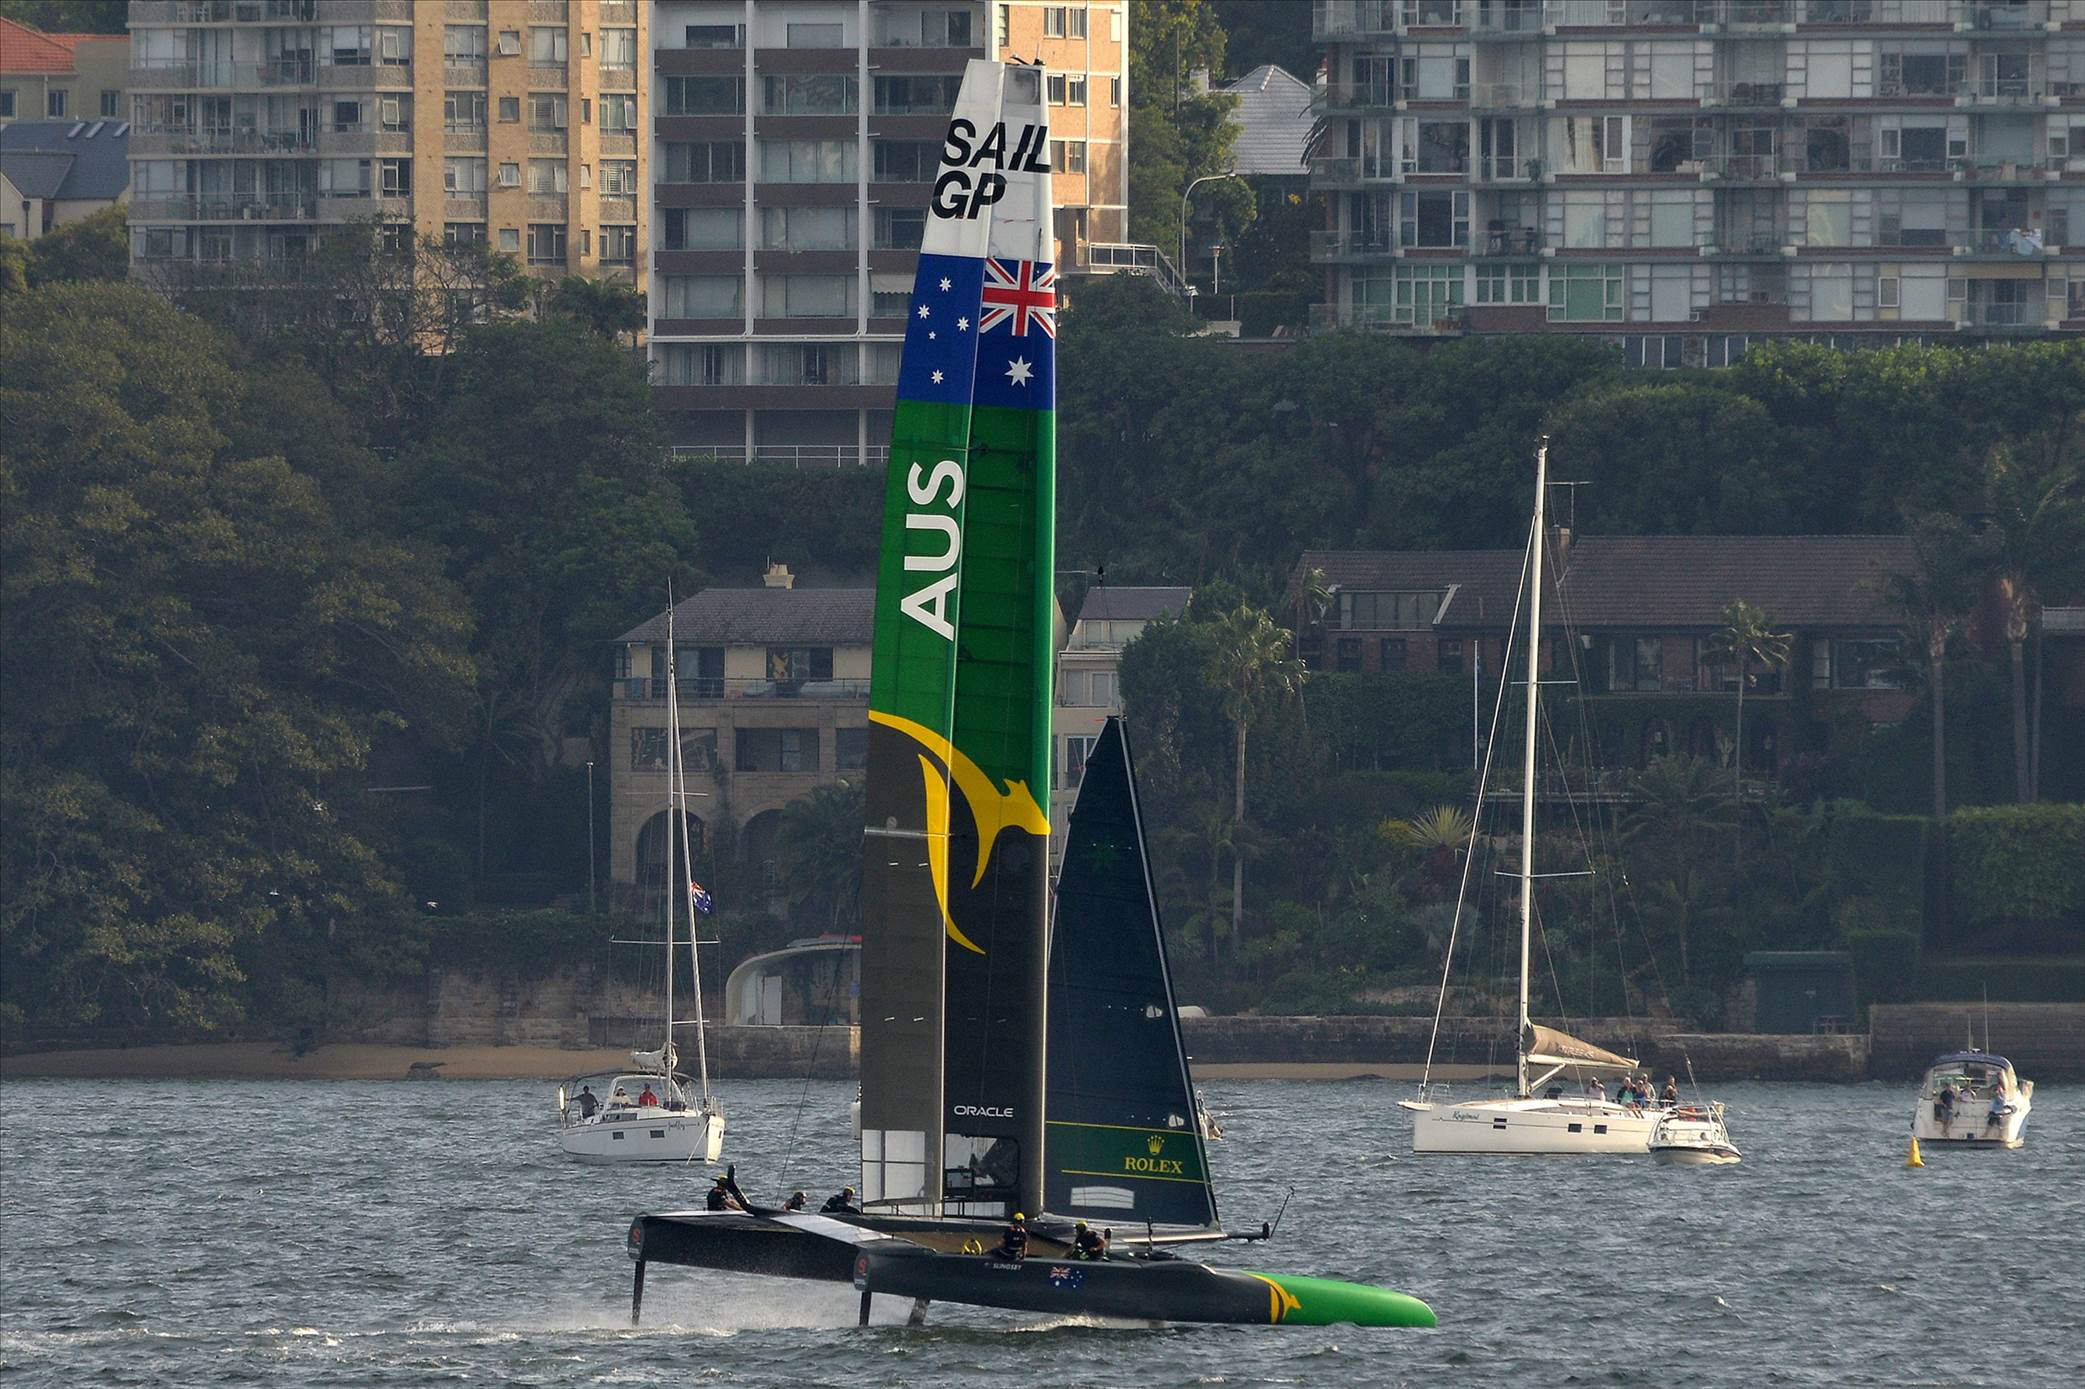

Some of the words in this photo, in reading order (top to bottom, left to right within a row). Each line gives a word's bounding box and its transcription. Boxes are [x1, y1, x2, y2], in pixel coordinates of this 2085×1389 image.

[942, 118, 1051, 173] SAIL
[930, 170, 1007, 220] GP
[900, 459, 965, 642] AUS
[953, 1105, 1015, 1118] ORACLE
[1125, 1156, 1185, 1174] ROLEX
